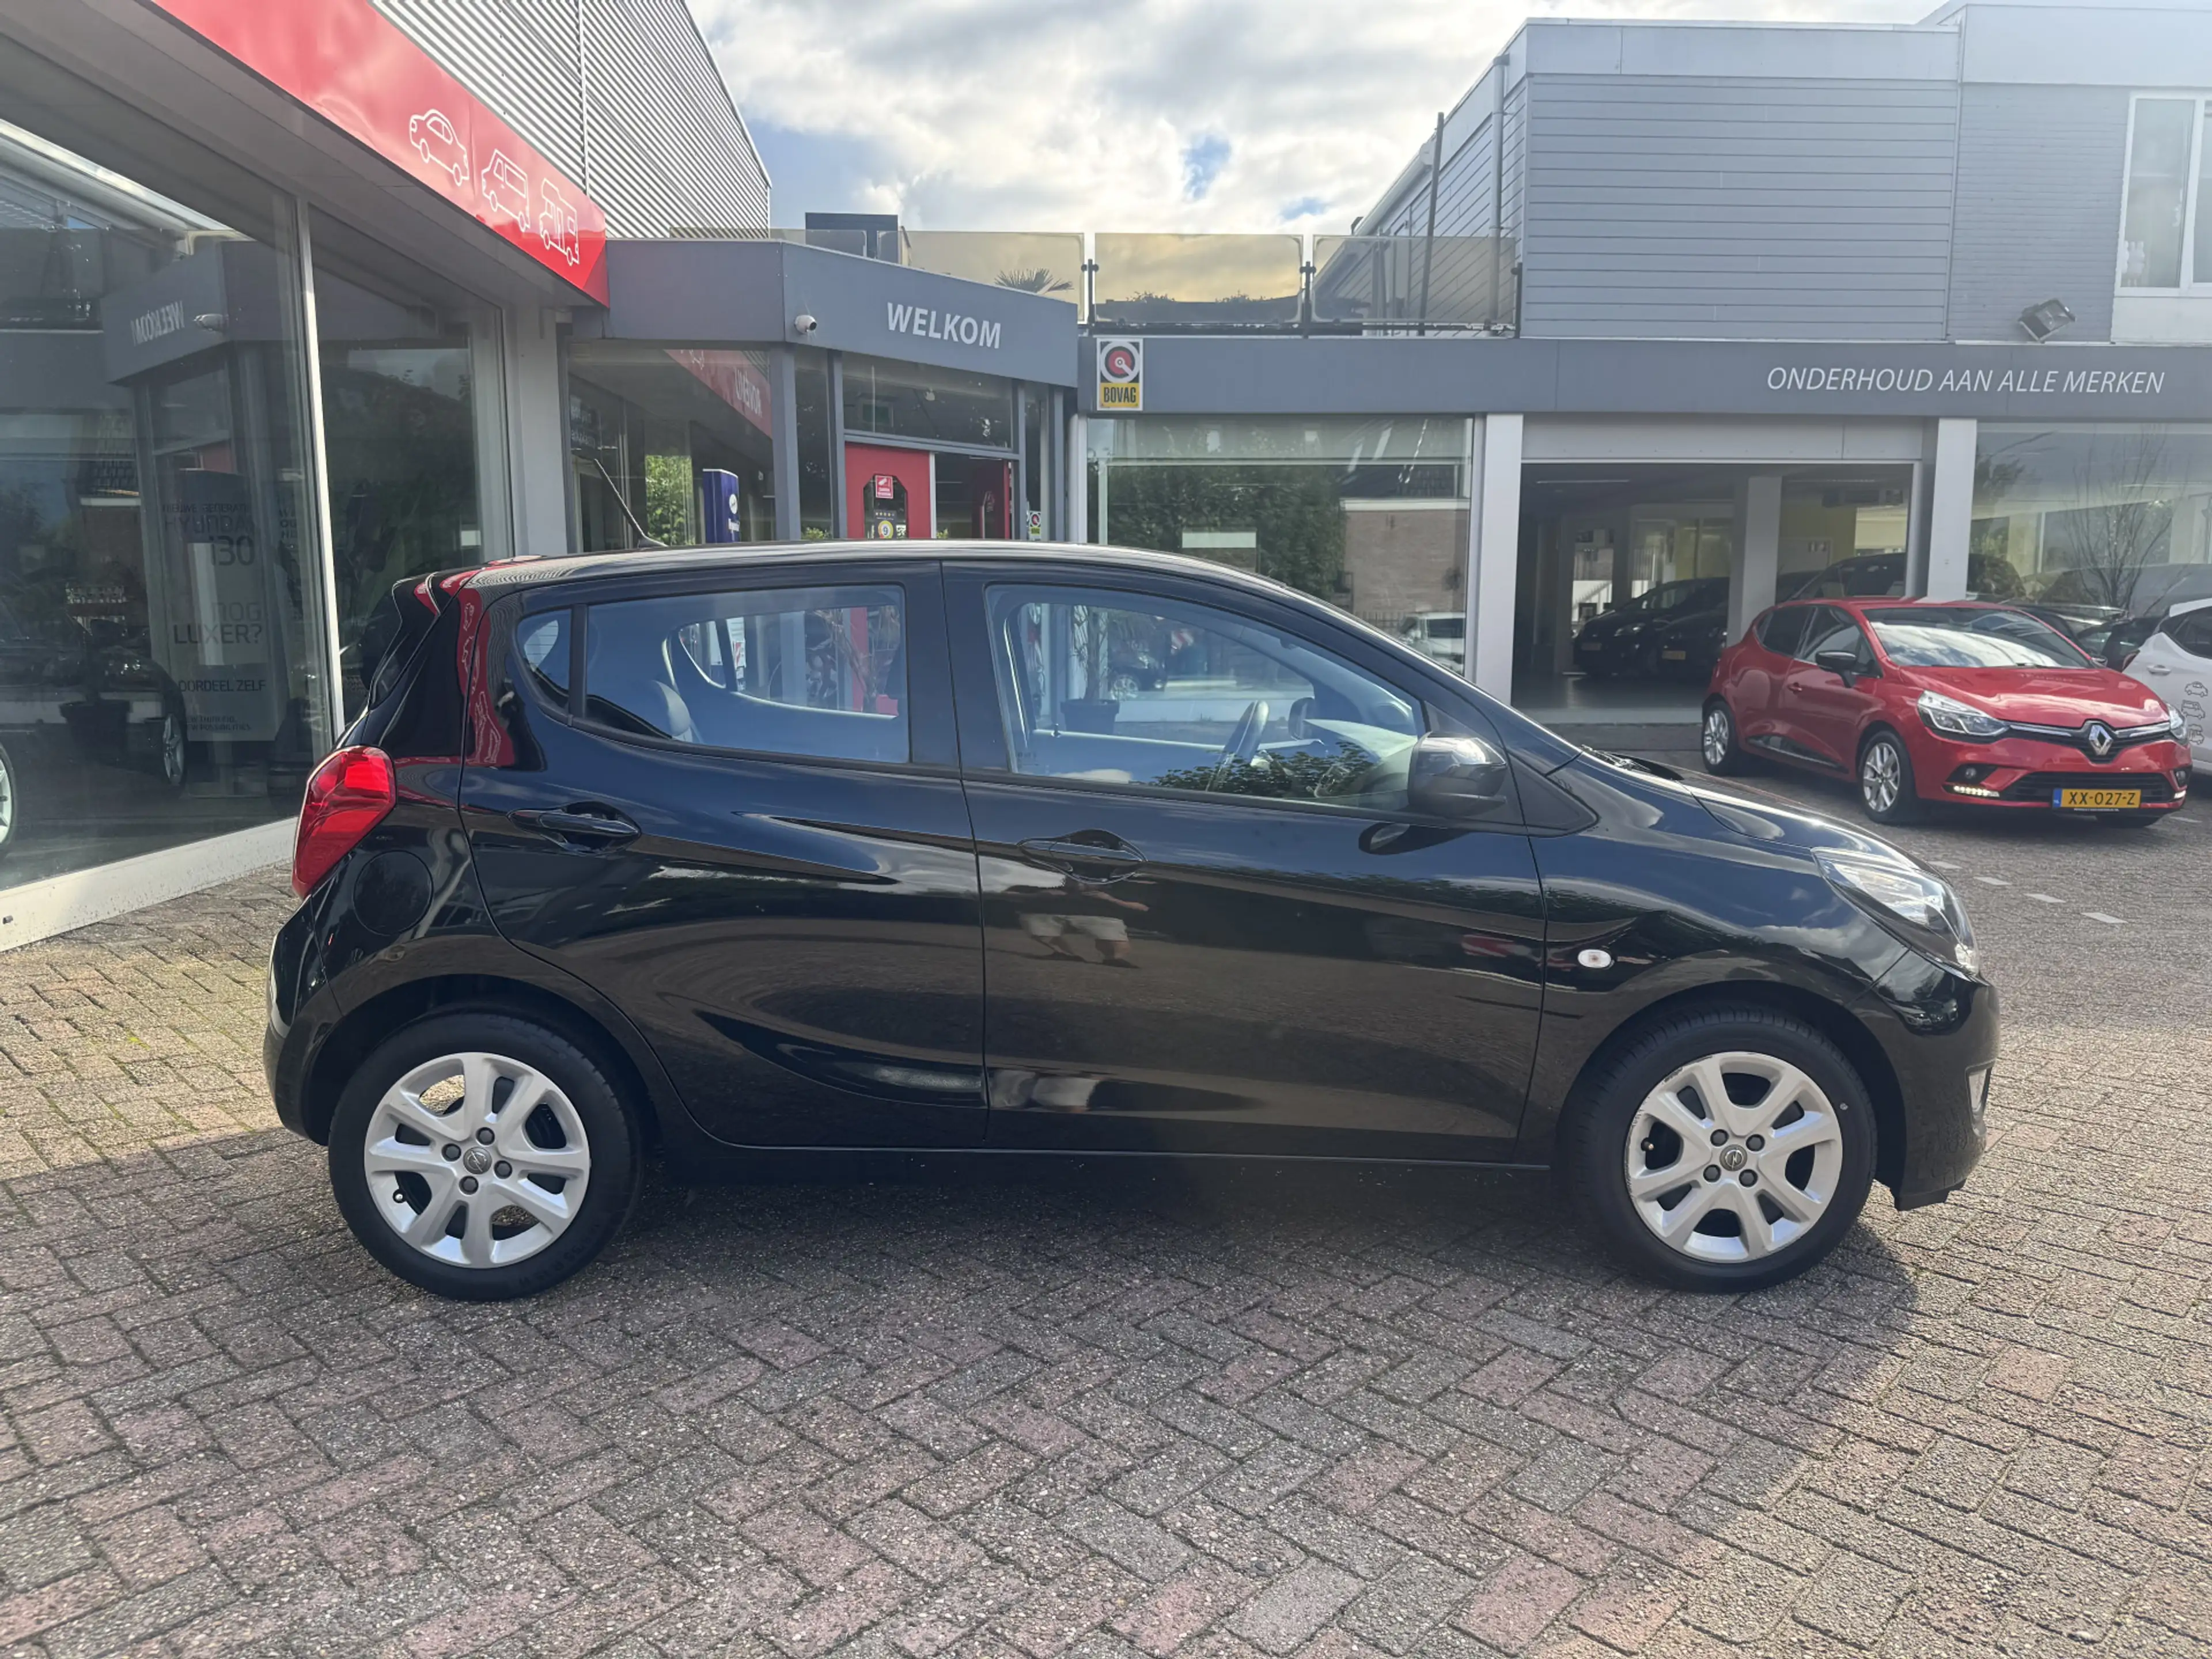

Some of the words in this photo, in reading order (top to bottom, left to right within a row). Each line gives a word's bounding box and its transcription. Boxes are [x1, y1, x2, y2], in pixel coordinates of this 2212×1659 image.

[887, 302, 1001, 349] WELKOM
[1767, 367, 1933, 391] ONDERHOUD
[1938, 369, 1993, 391] AAN
[1997, 370, 2059, 392] ALLE
[2062, 370, 2165, 393] MERKEN
[1103, 387, 1137, 404] BOVAG
[173, 623, 263, 645] LUXER?
[236, 679, 267, 692] ZELF
[2069, 791, 2135, 805] XX-027-Z
